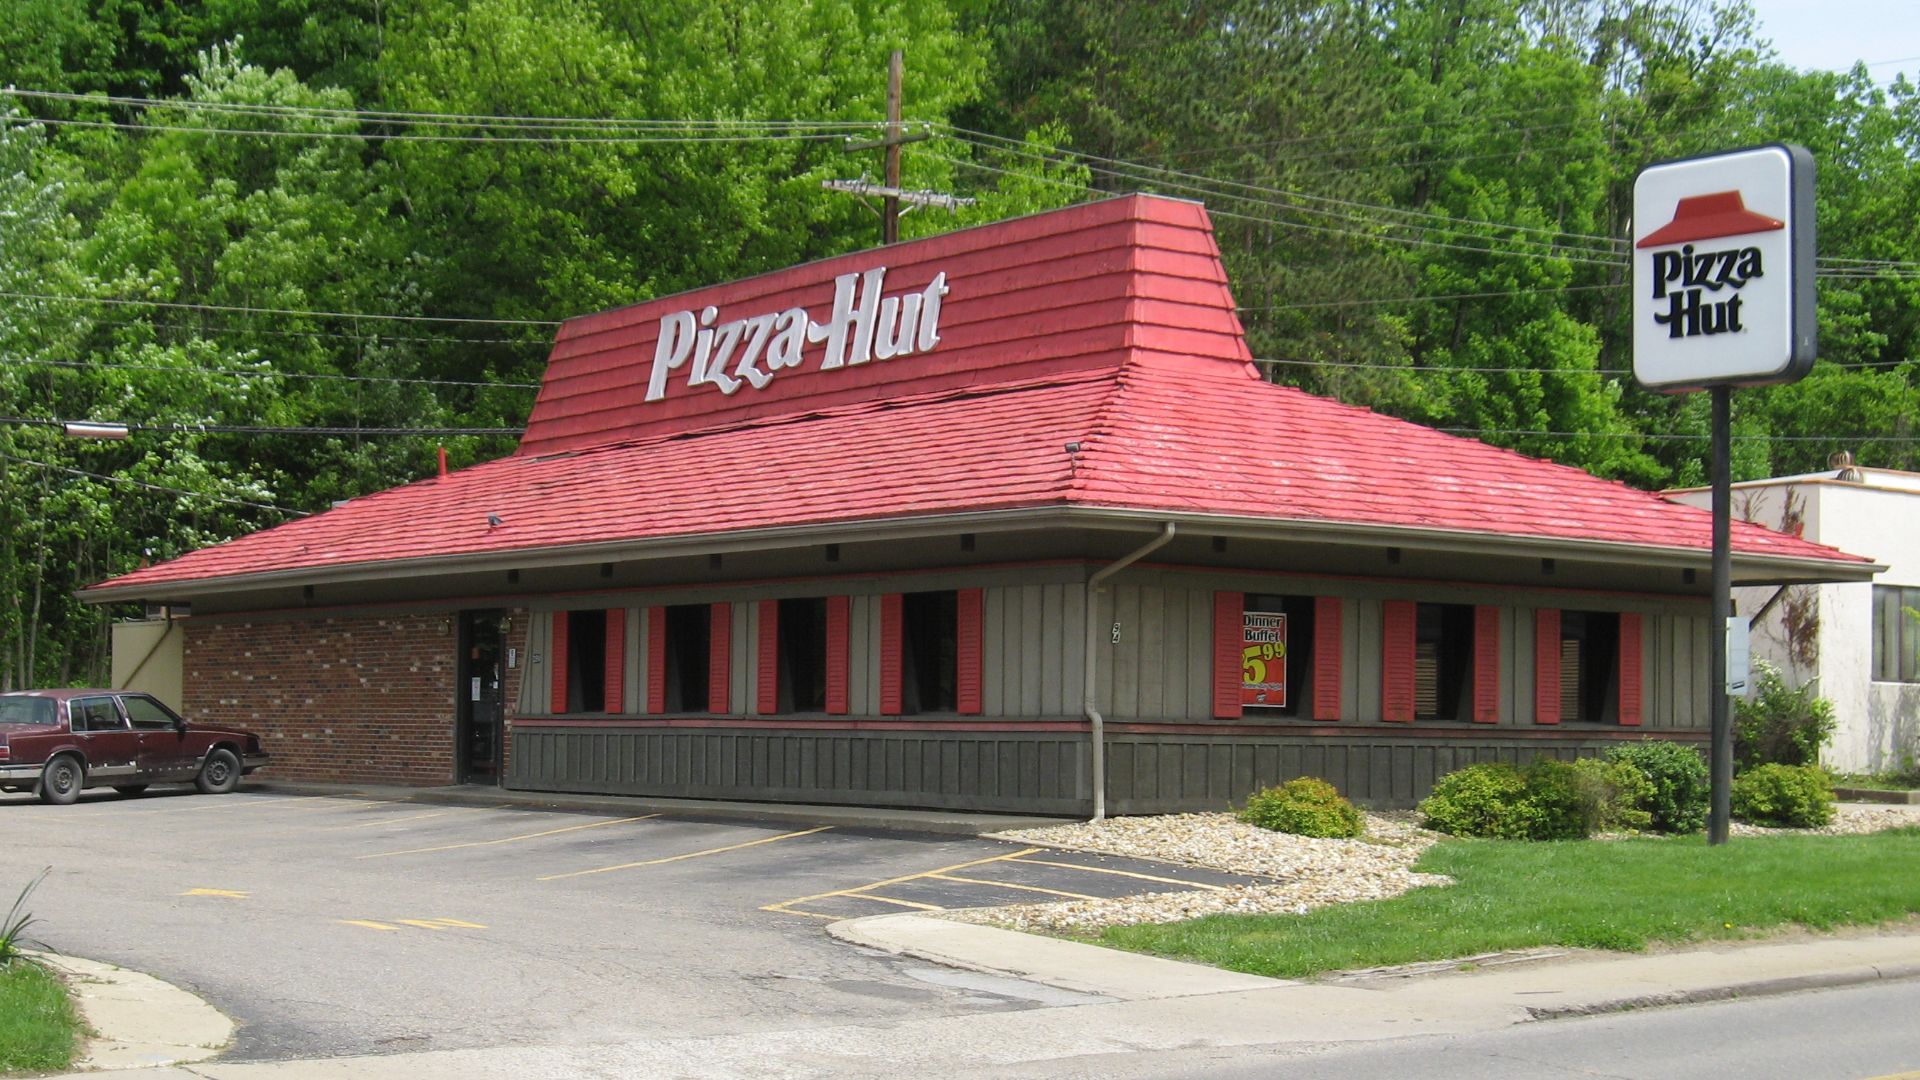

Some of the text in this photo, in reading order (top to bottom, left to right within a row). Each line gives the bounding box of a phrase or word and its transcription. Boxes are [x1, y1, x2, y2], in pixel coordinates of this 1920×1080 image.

[1652, 245, 1763, 298] Pizza
[645, 267, 949, 401] Pizza Hut
[1654, 289, 1743, 338] Hut
[1243, 615, 1282, 627] Dinner
[1244, 629, 1281, 642] Buffet
